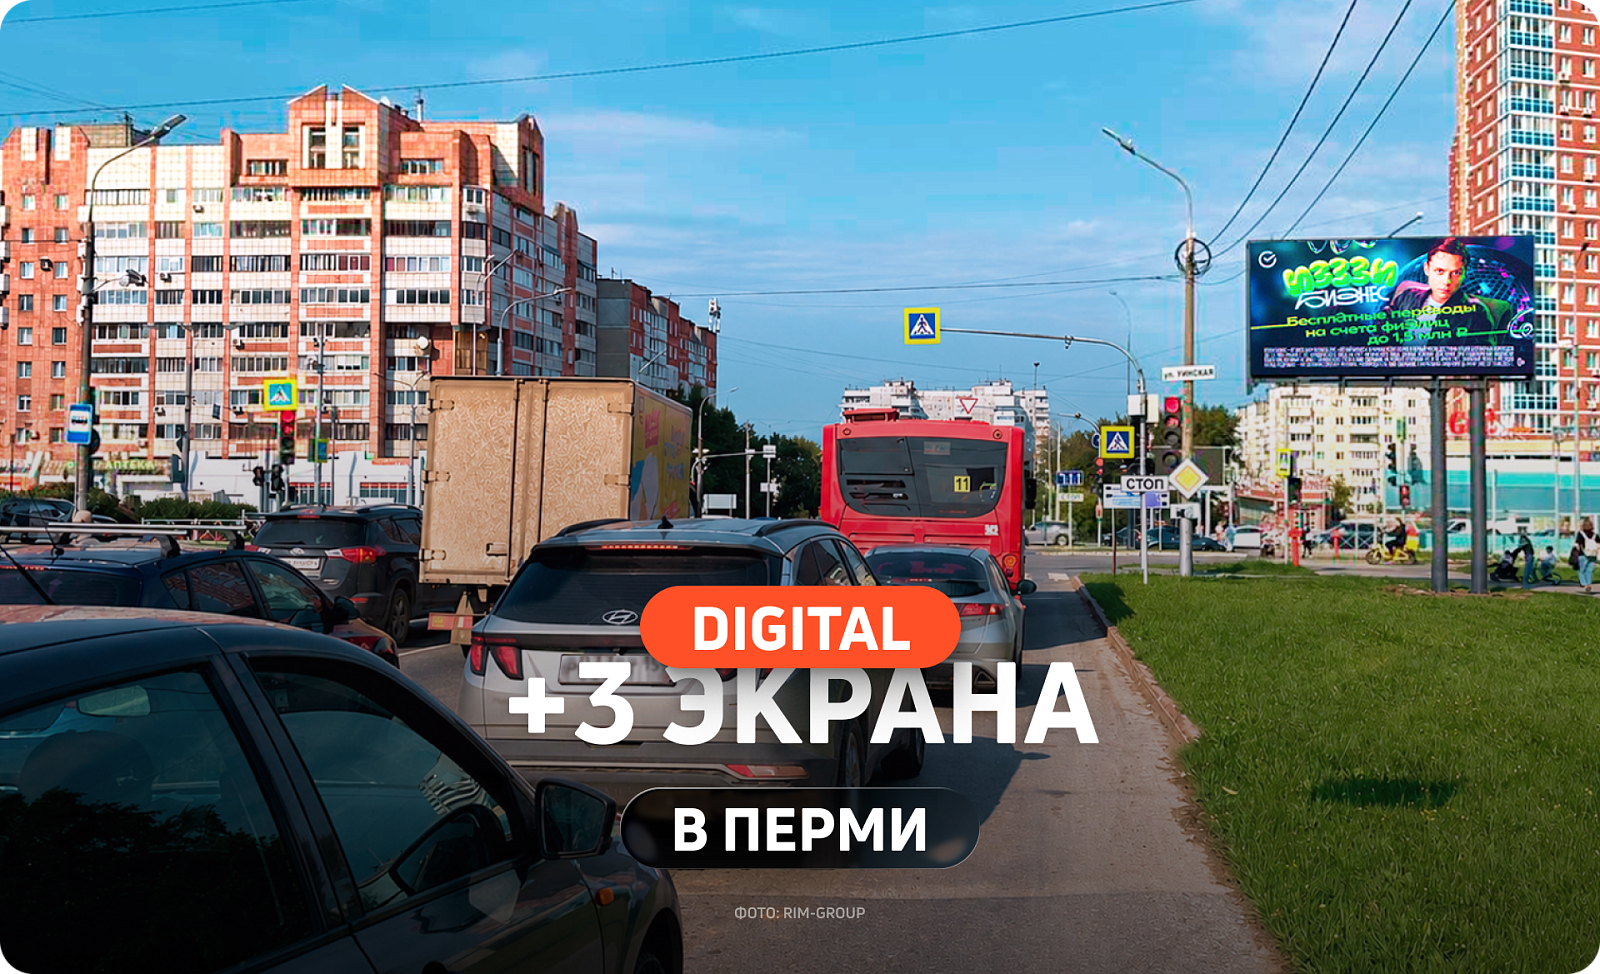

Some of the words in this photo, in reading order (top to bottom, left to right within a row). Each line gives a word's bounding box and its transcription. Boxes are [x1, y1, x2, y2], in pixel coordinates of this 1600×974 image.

[1286, 312, 1387, 327] Бесплатные
[1391, 304, 1476, 318] переводы
[1305, 328, 1326, 338] на
[1330, 324, 1377, 336] счета
[1367, 334, 1389, 346] до
[1418, 331, 1452, 341] млн
[107, 459, 155, 470] АПТЕКА
[955, 477, 969, 491] 11
[1126, 478, 1164, 490] СТОП
